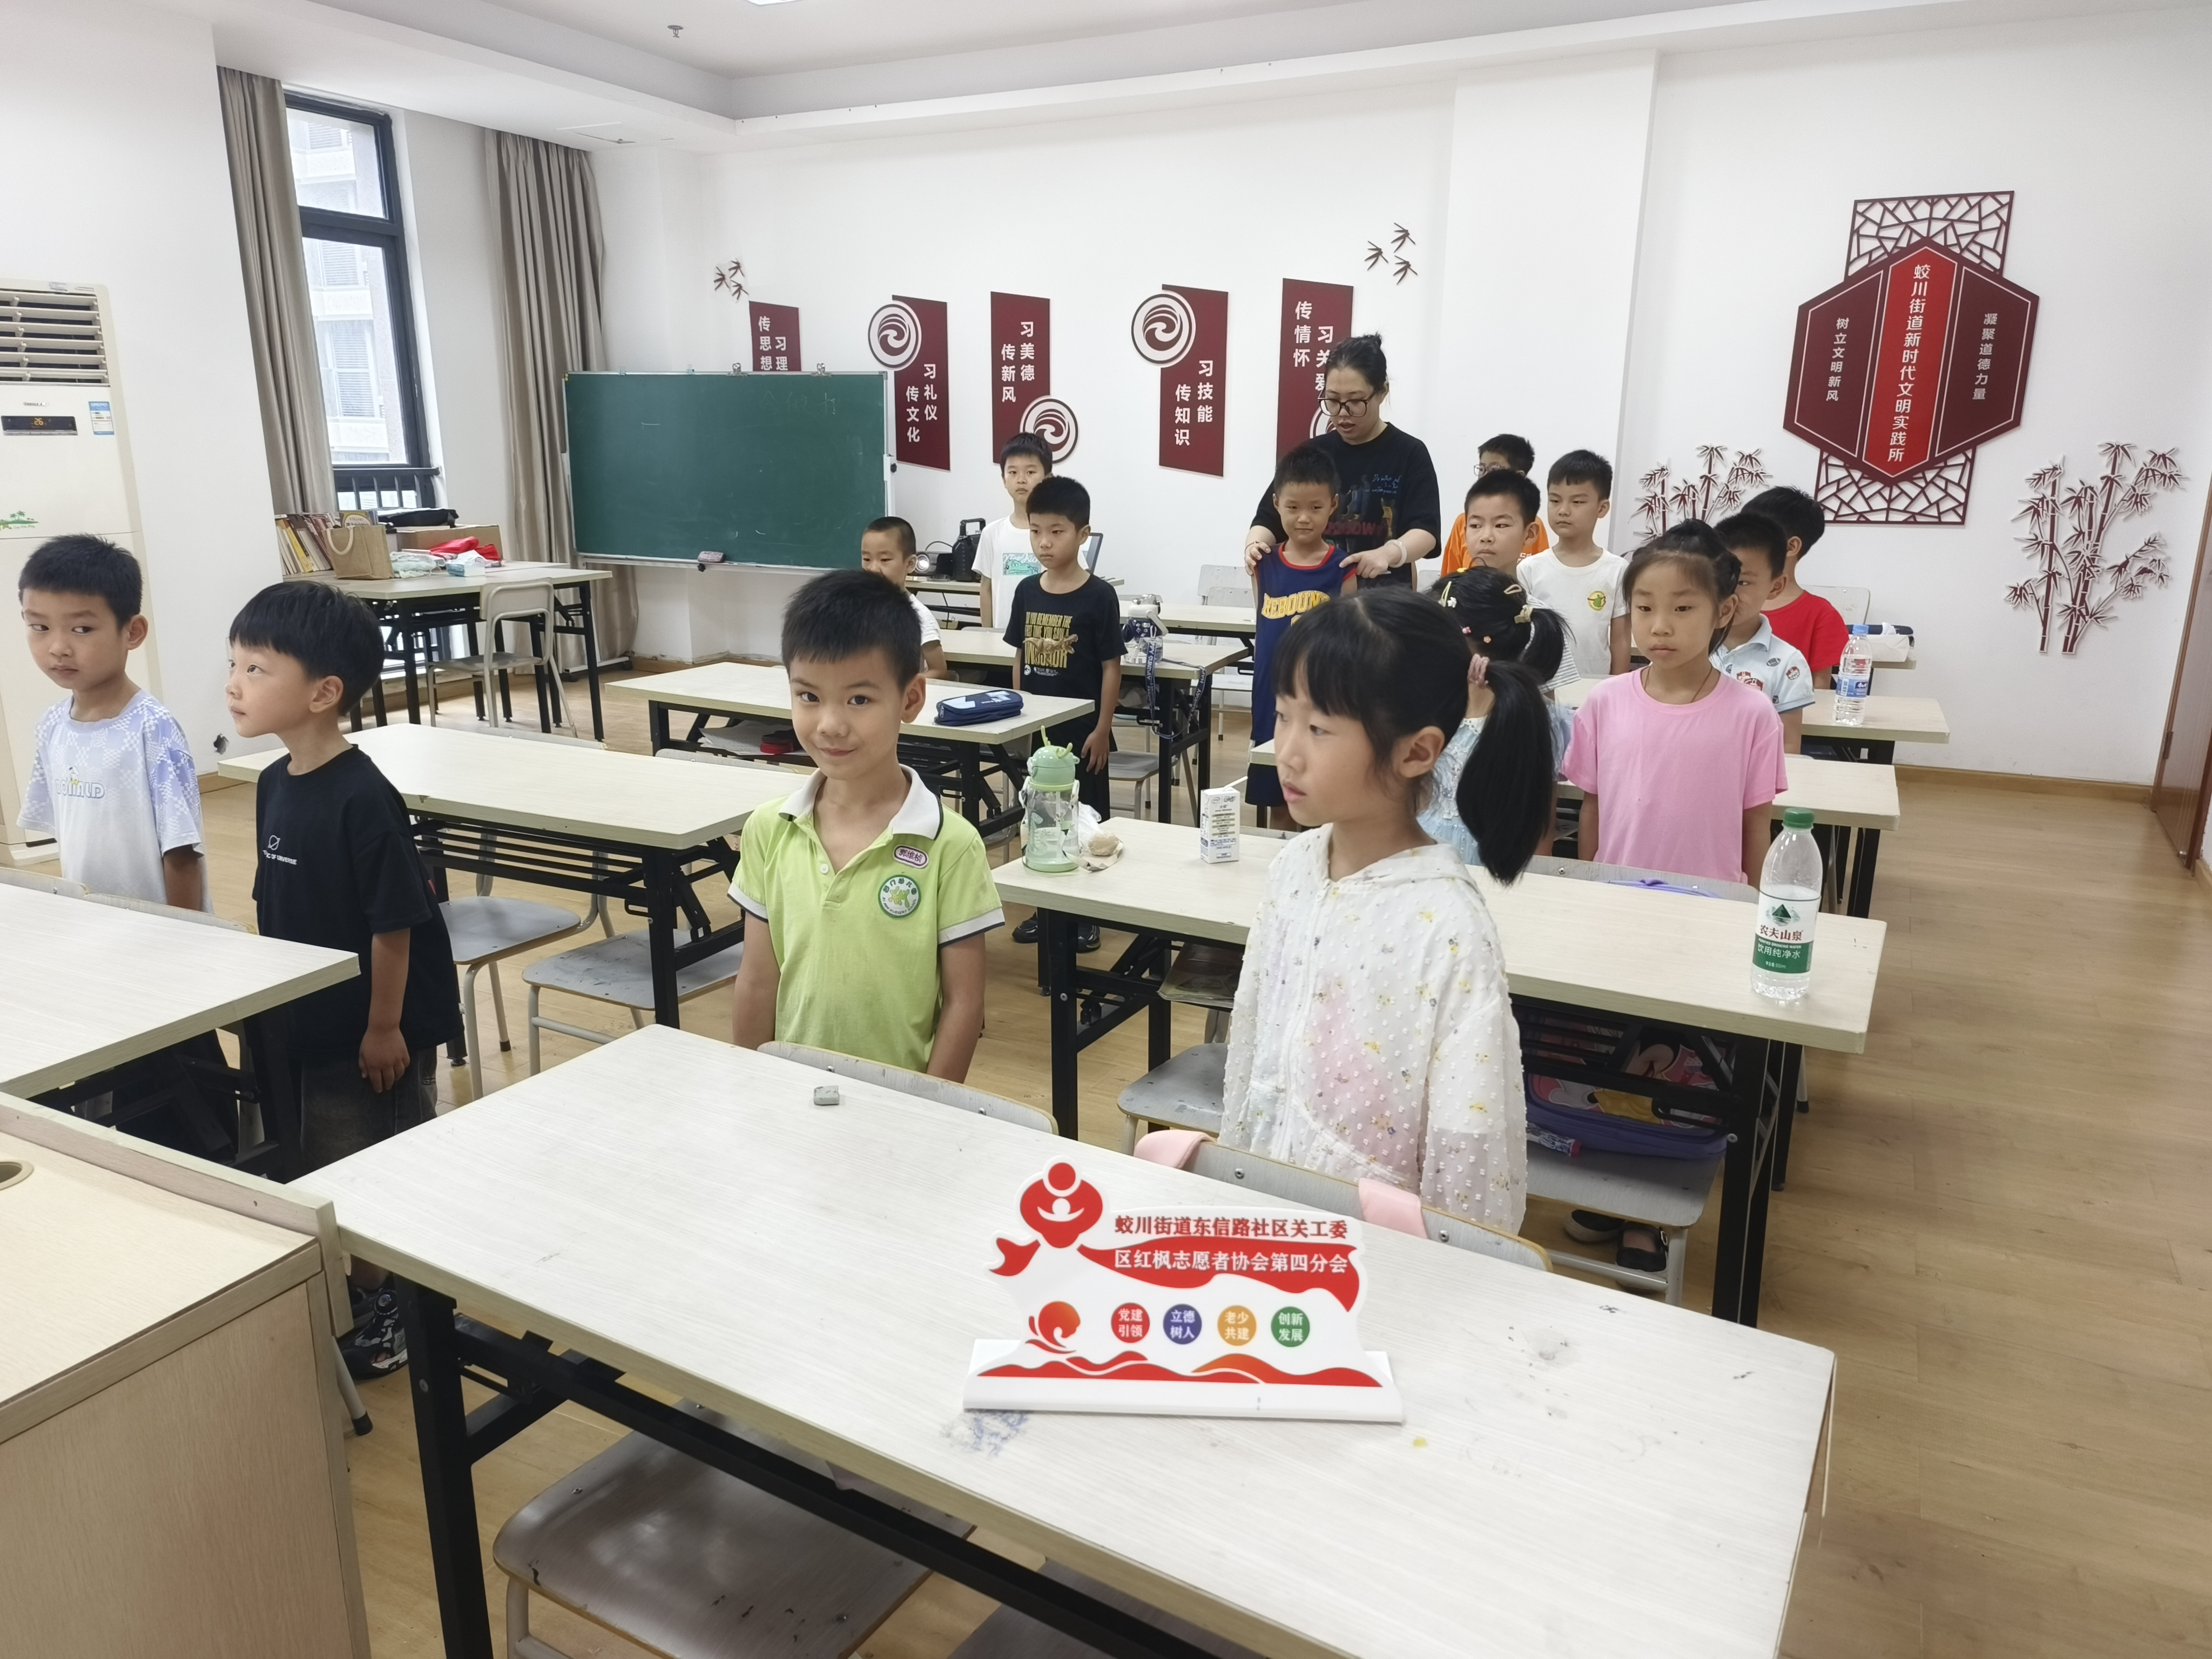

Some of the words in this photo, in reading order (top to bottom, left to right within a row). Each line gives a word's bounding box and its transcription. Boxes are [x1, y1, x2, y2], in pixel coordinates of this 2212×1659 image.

[758, 316, 773, 370] 传思想
[1293, 301, 1312, 367] 传情怀
[1020, 321, 1035, 381] 习美德
[1826, 318, 1849, 402] 树立文明新风
[1887, 264, 1931, 462] 蛟川街道新时代文明实践所
[1972, 313, 1998, 400] 凝聚道德力量
[1001, 343, 1016, 403] 传新风
[923, 363, 938, 421] 习礼仪
[1197, 360, 1213, 423] 习技能
[33, 417, 44, 426] 26
[906, 386, 920, 442] 传文化
[1175, 384, 1191, 446] 传知识
[1036, 612, 1063, 627] REMEMBER
[1062, 615, 1073, 628] THE
[1760, 925, 1802, 941] 农夫山泉
[1757, 942, 1801, 959] 饮用纯净水
[1115, 1215, 1348, 1239] 蛟川街道东信路社区关工委
[1114, 1249, 1348, 1273] 区红枫志愿者协会第四分会
[1118, 1309, 1143, 1322] 党建
[1170, 1310, 1196, 1323] 立德
[1224, 1311, 1250, 1325] 老少
[1278, 1312, 1304, 1326] 创新
[1118, 1324, 1143, 1338] 引领
[1170, 1326, 1195, 1339] 树人
[1224, 1327, 1250, 1340] 共建
[1278, 1328, 1304, 1342] 发展
